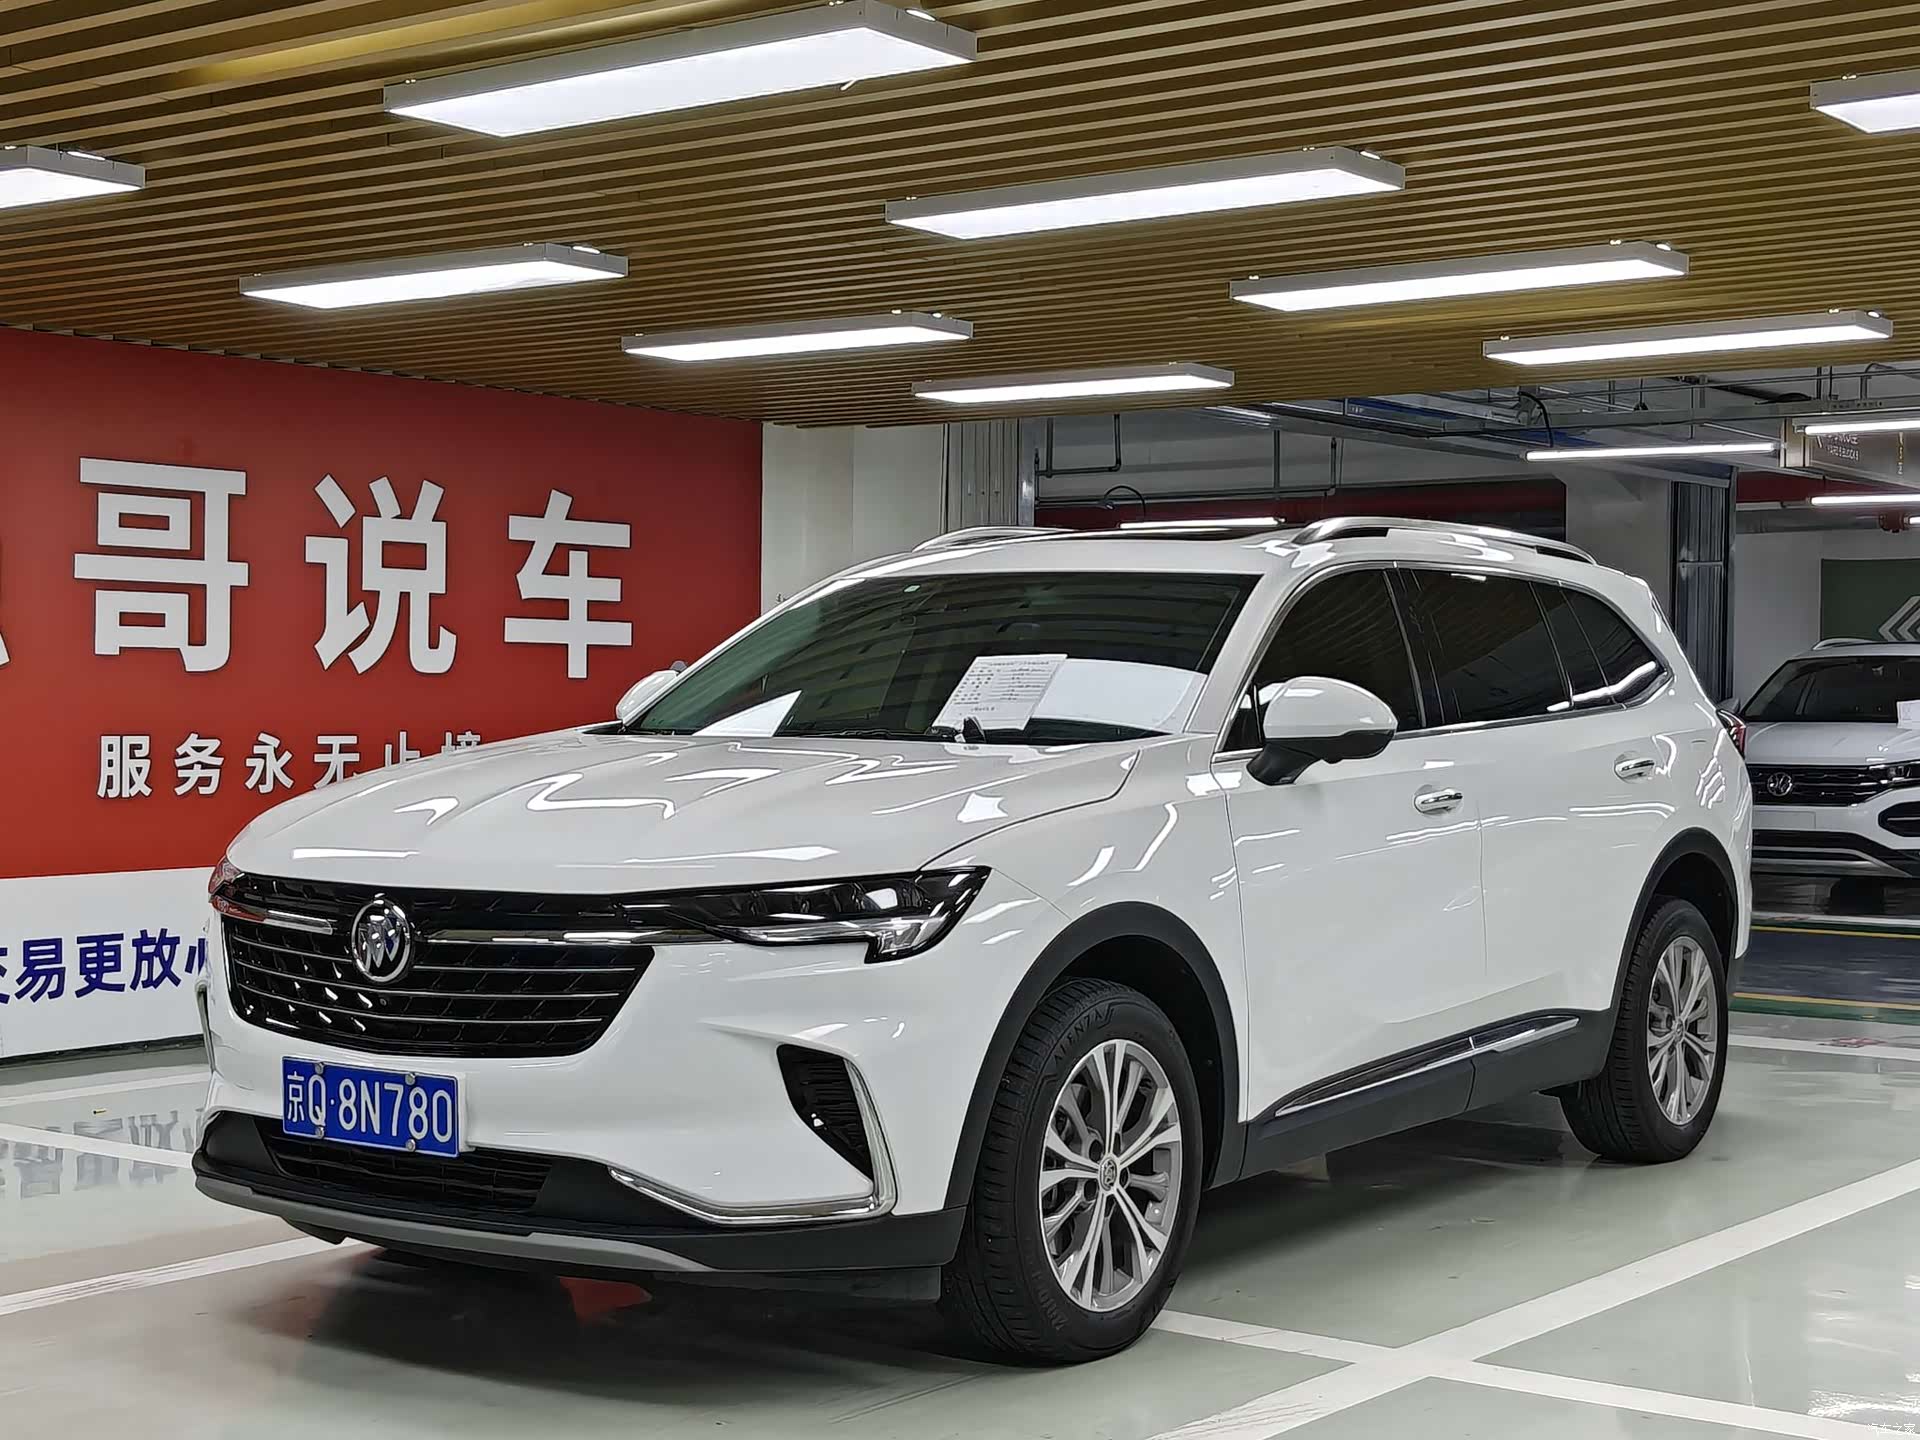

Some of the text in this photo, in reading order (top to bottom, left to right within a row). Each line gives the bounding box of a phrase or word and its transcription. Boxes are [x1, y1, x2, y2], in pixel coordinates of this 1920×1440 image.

[0, 457, 633, 679] 哥说车
[0, 928, 207, 1004] 易更放
